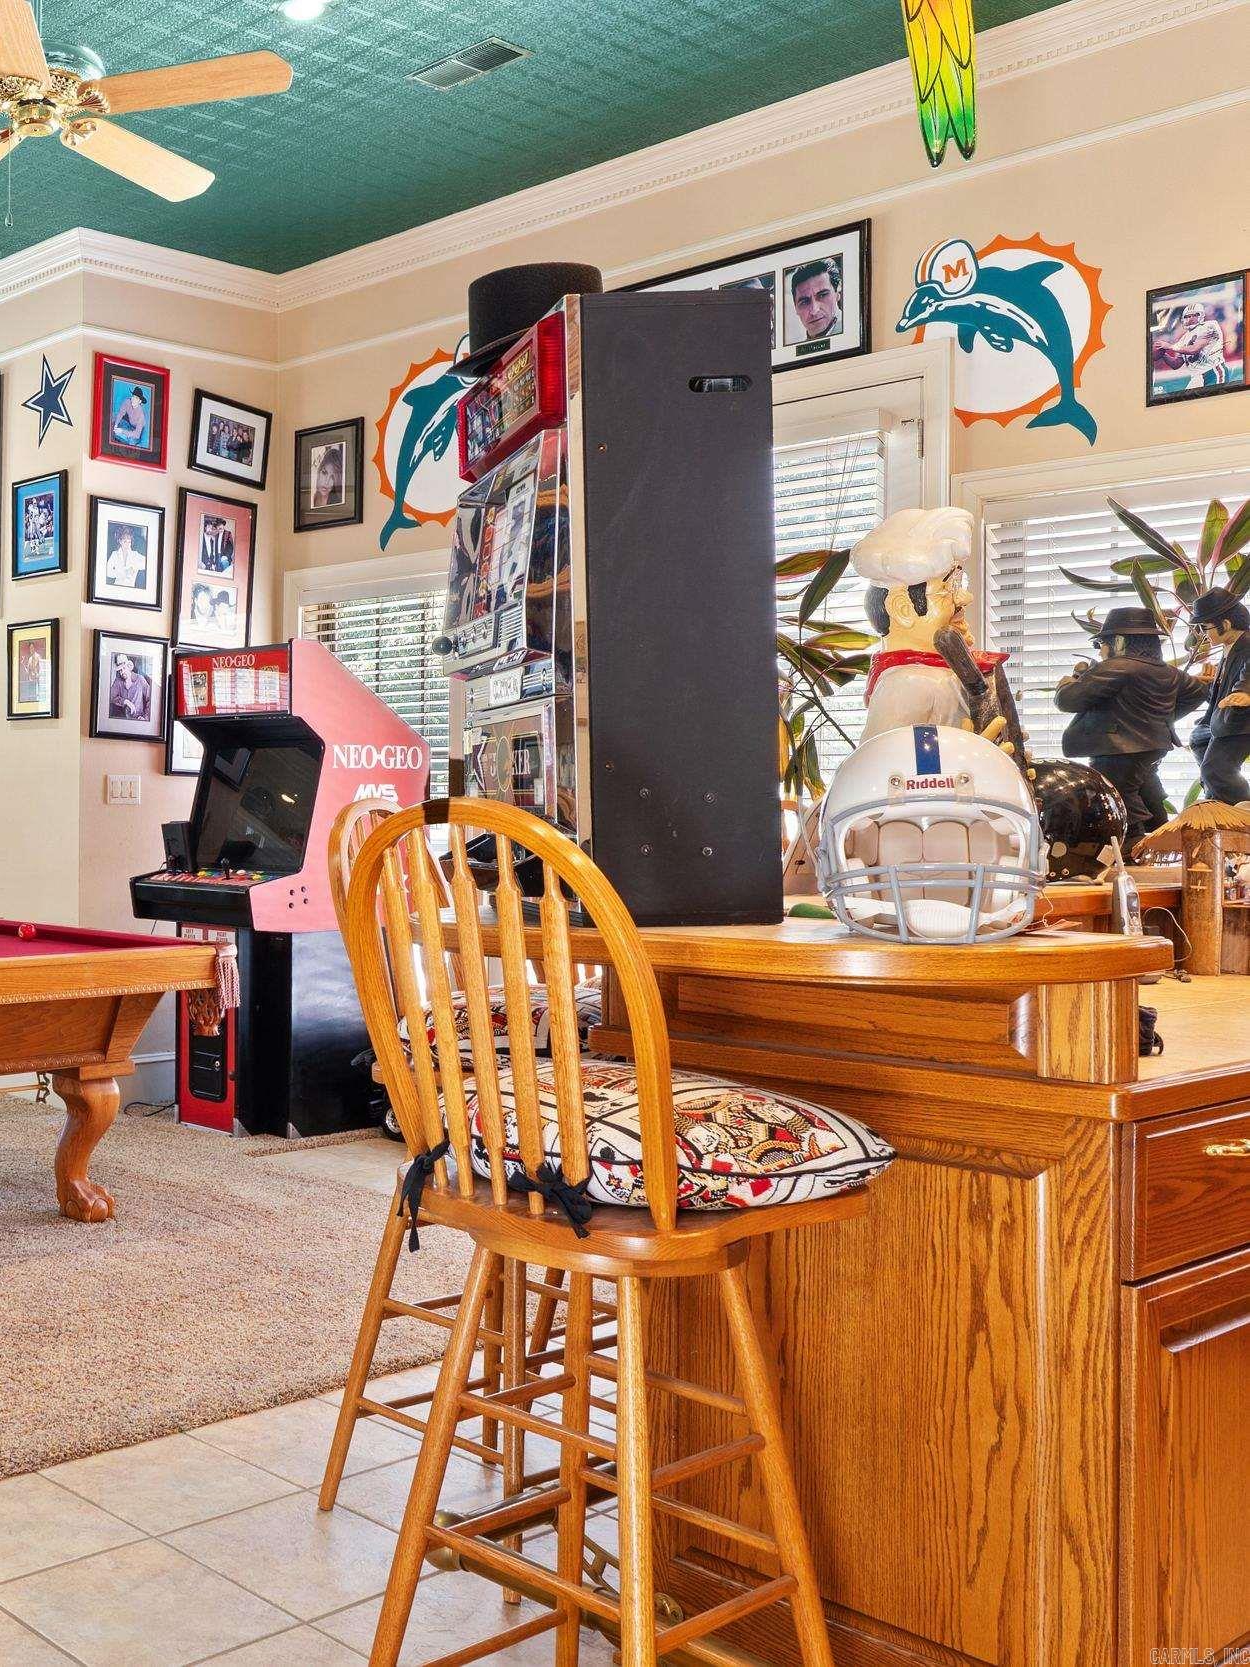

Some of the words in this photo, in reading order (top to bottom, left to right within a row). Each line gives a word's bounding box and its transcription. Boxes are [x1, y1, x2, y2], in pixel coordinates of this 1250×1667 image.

[942, 257, 970, 284] M
[353, 783, 399, 804] MVS
[906, 777, 955, 791] Riddell
